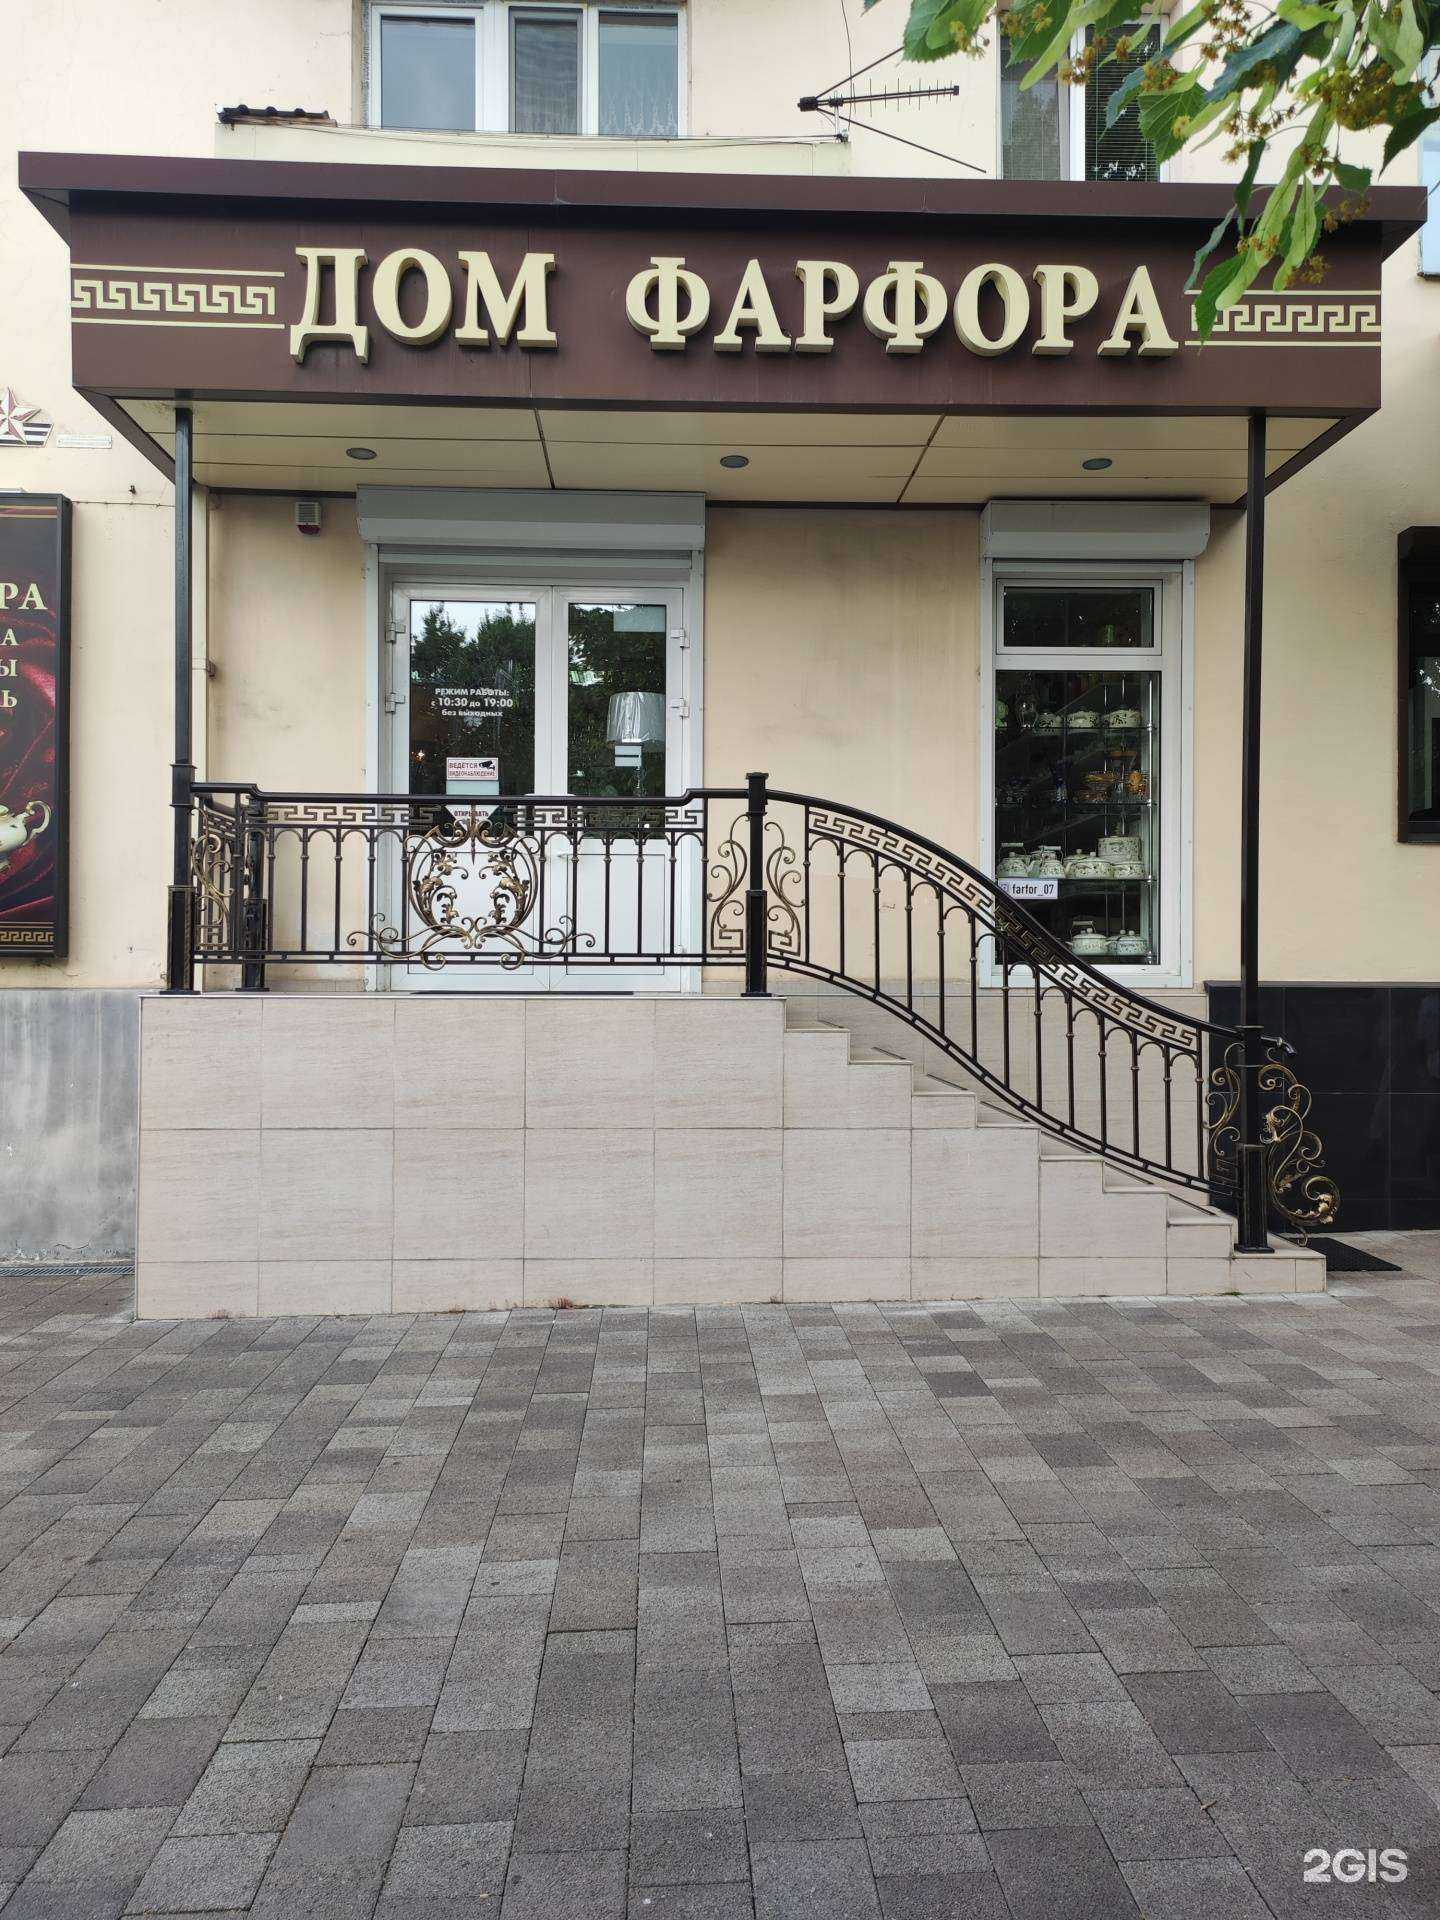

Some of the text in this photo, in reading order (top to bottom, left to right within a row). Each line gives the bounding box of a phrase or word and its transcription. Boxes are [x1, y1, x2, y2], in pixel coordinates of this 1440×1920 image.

[289, 246, 1181, 365] ДОМ ФАРФОРА
[435, 688, 469, 696] РЕЖИМ
[438, 697, 468, 707] 10:30
[484, 698, 513, 708] 19:00
[1012, 883, 1055, 896] farfor_07
